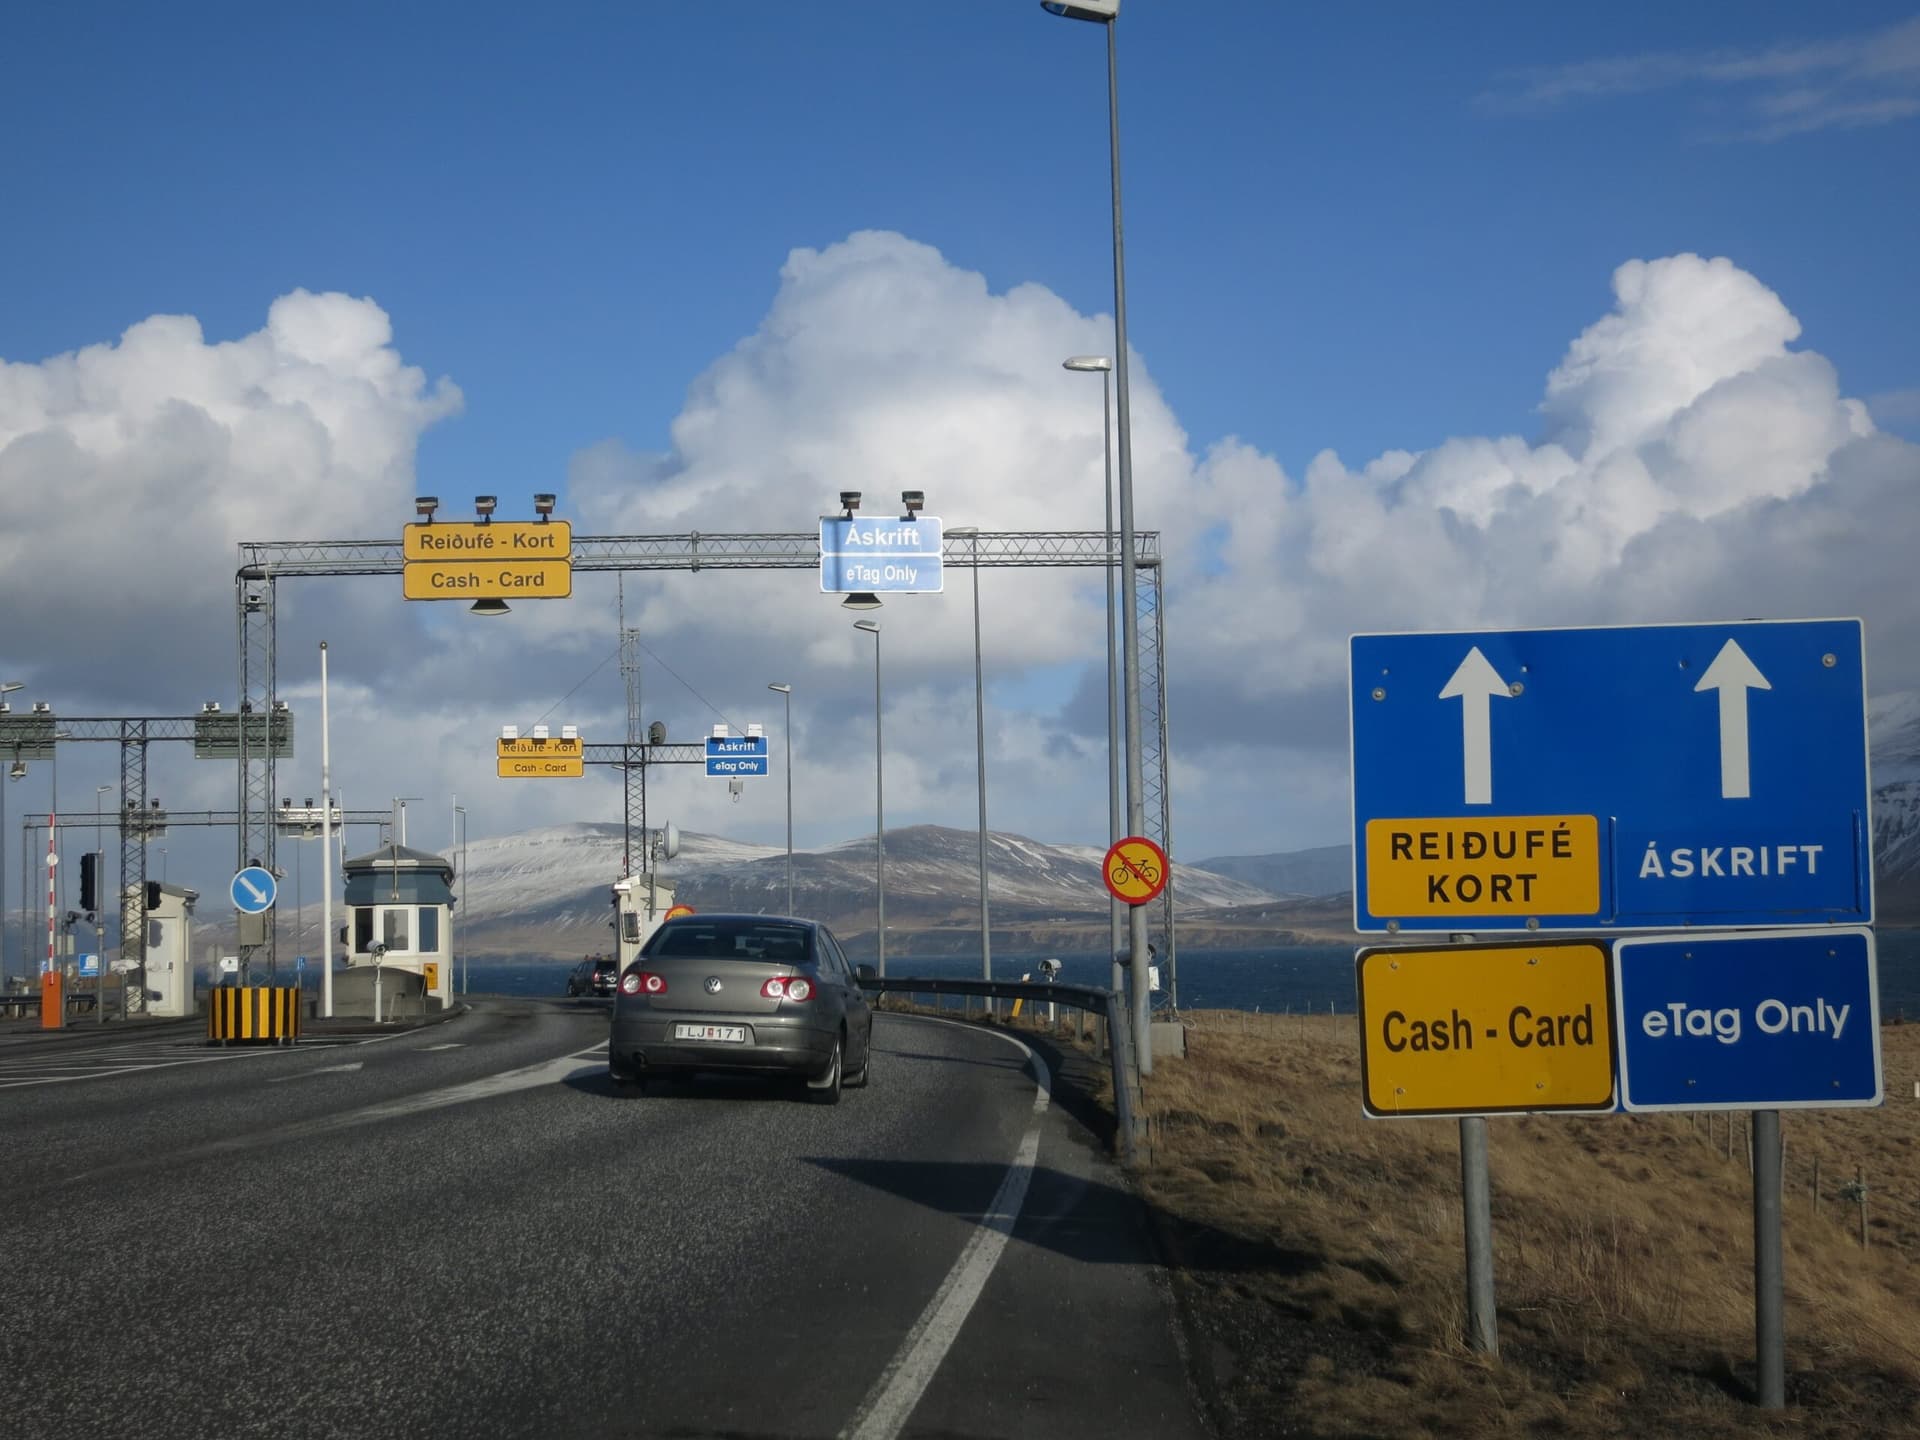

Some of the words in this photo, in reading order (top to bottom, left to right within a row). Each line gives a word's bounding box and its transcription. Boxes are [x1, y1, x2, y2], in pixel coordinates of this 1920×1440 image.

[420, 533, 494, 549] Reiðufé
[513, 532, 555, 548] Kort
[845, 523, 921, 545] Áskrift
[430, 572, 480, 588] Cash
[499, 571, 545, 587] Card
[846, 565, 880, 584] eTag
[884, 564, 918, 584] Only
[554, 743, 577, 752] Kort
[514, 763, 537, 772] Cash
[544, 763, 567, 772] Card
[738, 761, 759, 771] Only
[1391, 822, 1573, 860] REIÐUFÉ
[1639, 841, 1823, 879] ÁSKRIFT
[1428, 874, 1538, 904] KORT
[1382, 1009, 1473, 1053] Cash
[1508, 1004, 1594, 1049] Card
[1642, 1003, 1741, 1044] eTag
[1755, 998, 1850, 1040] Only
